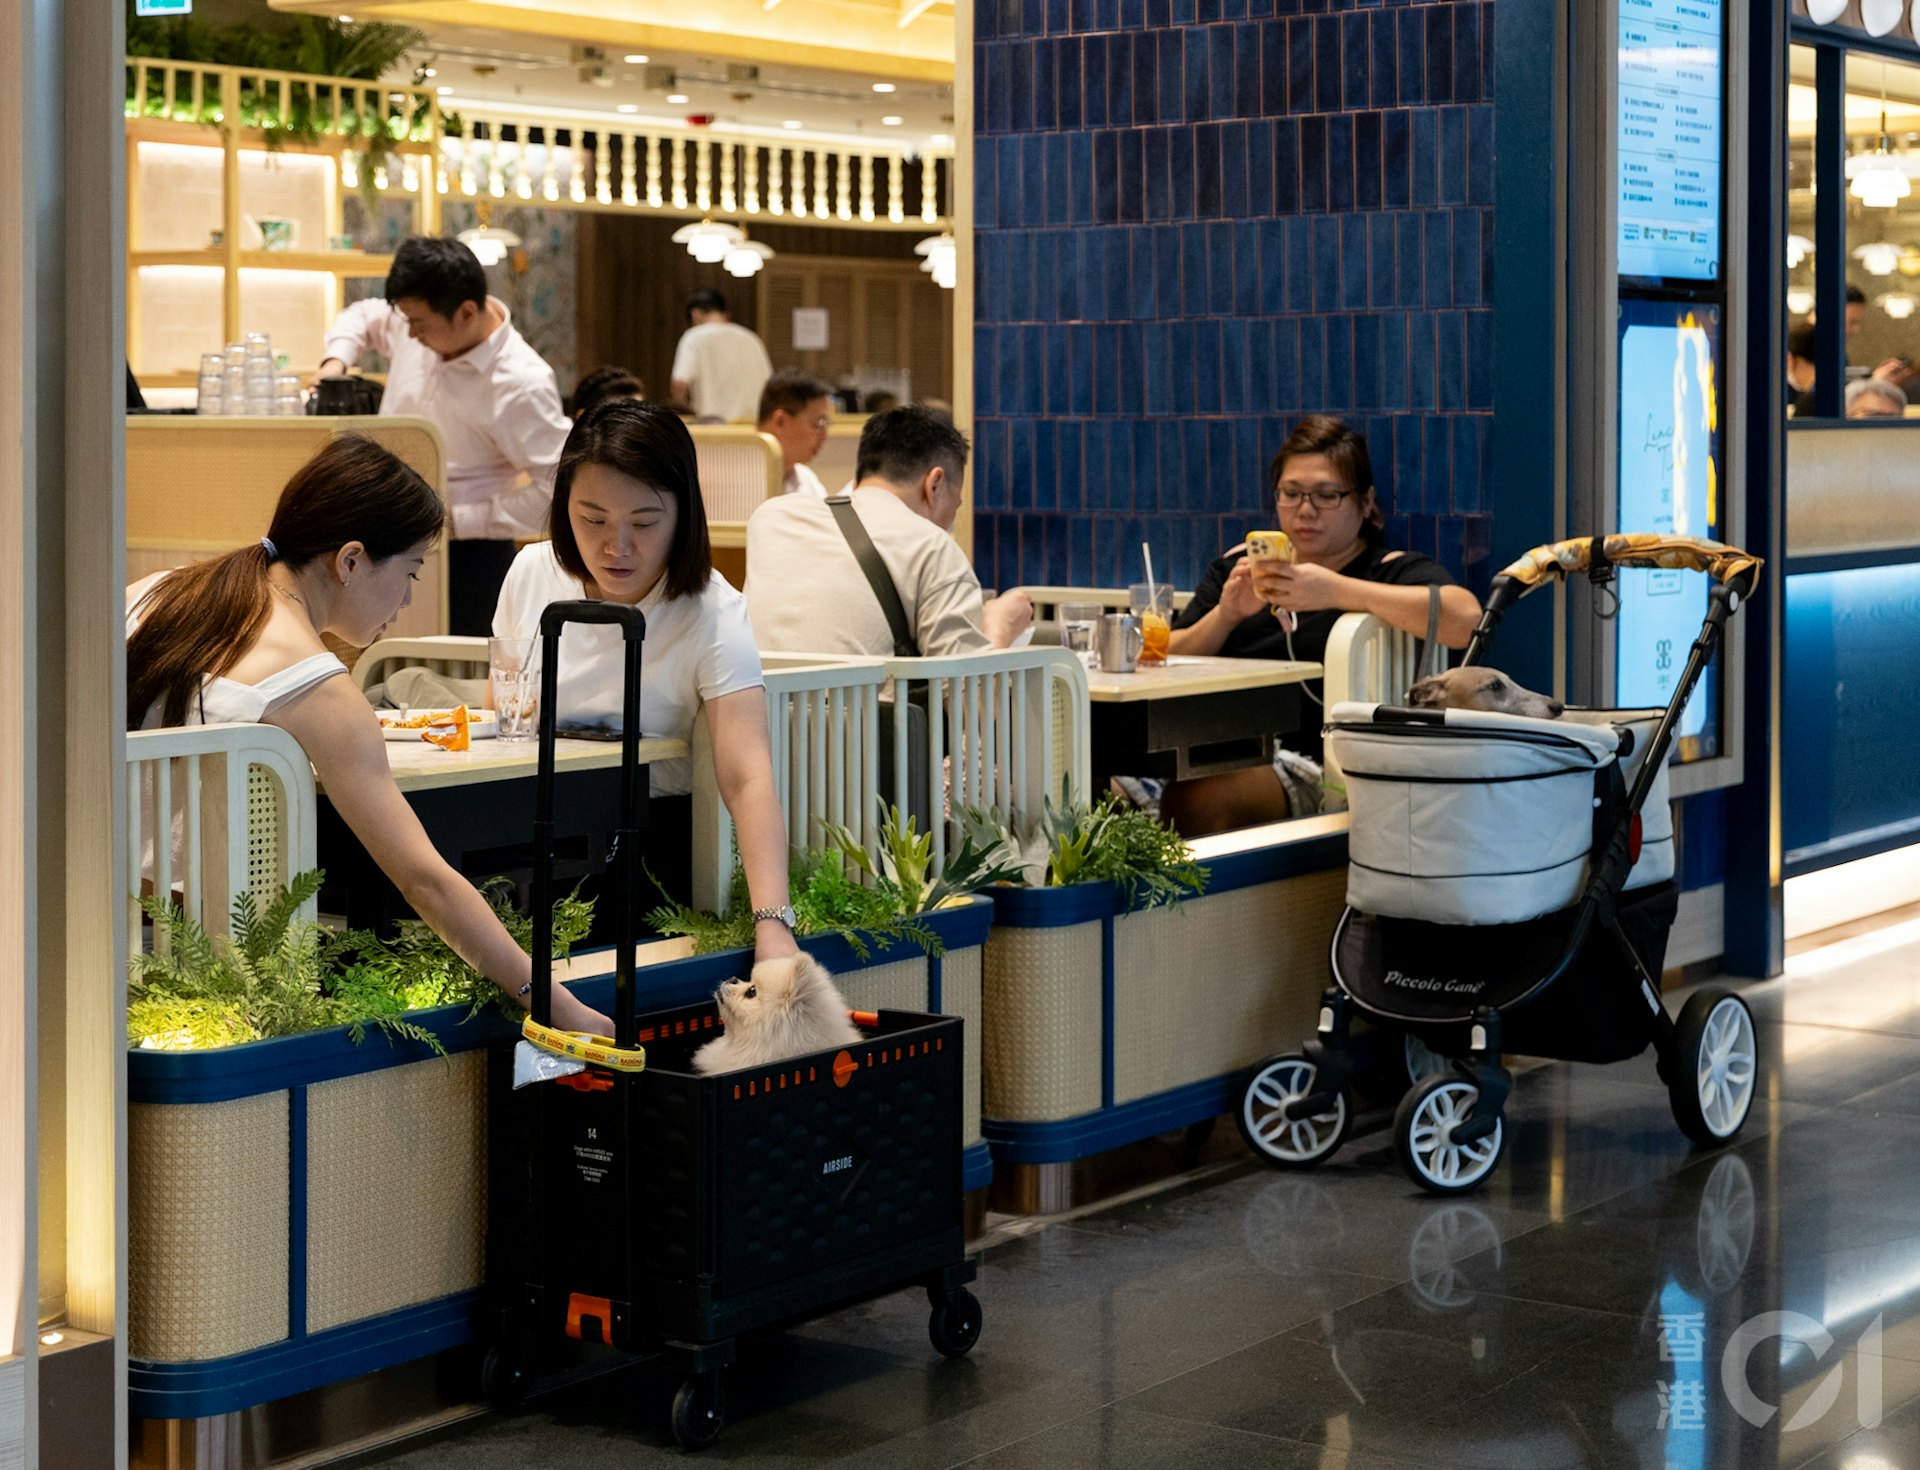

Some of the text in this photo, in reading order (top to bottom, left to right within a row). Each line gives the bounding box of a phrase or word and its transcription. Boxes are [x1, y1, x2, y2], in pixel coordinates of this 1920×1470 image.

[1384, 971, 1442, 991] Piccolo
[587, 1127, 597, 1140] 14
[822, 1155, 853, 1175] AIRSIDE
